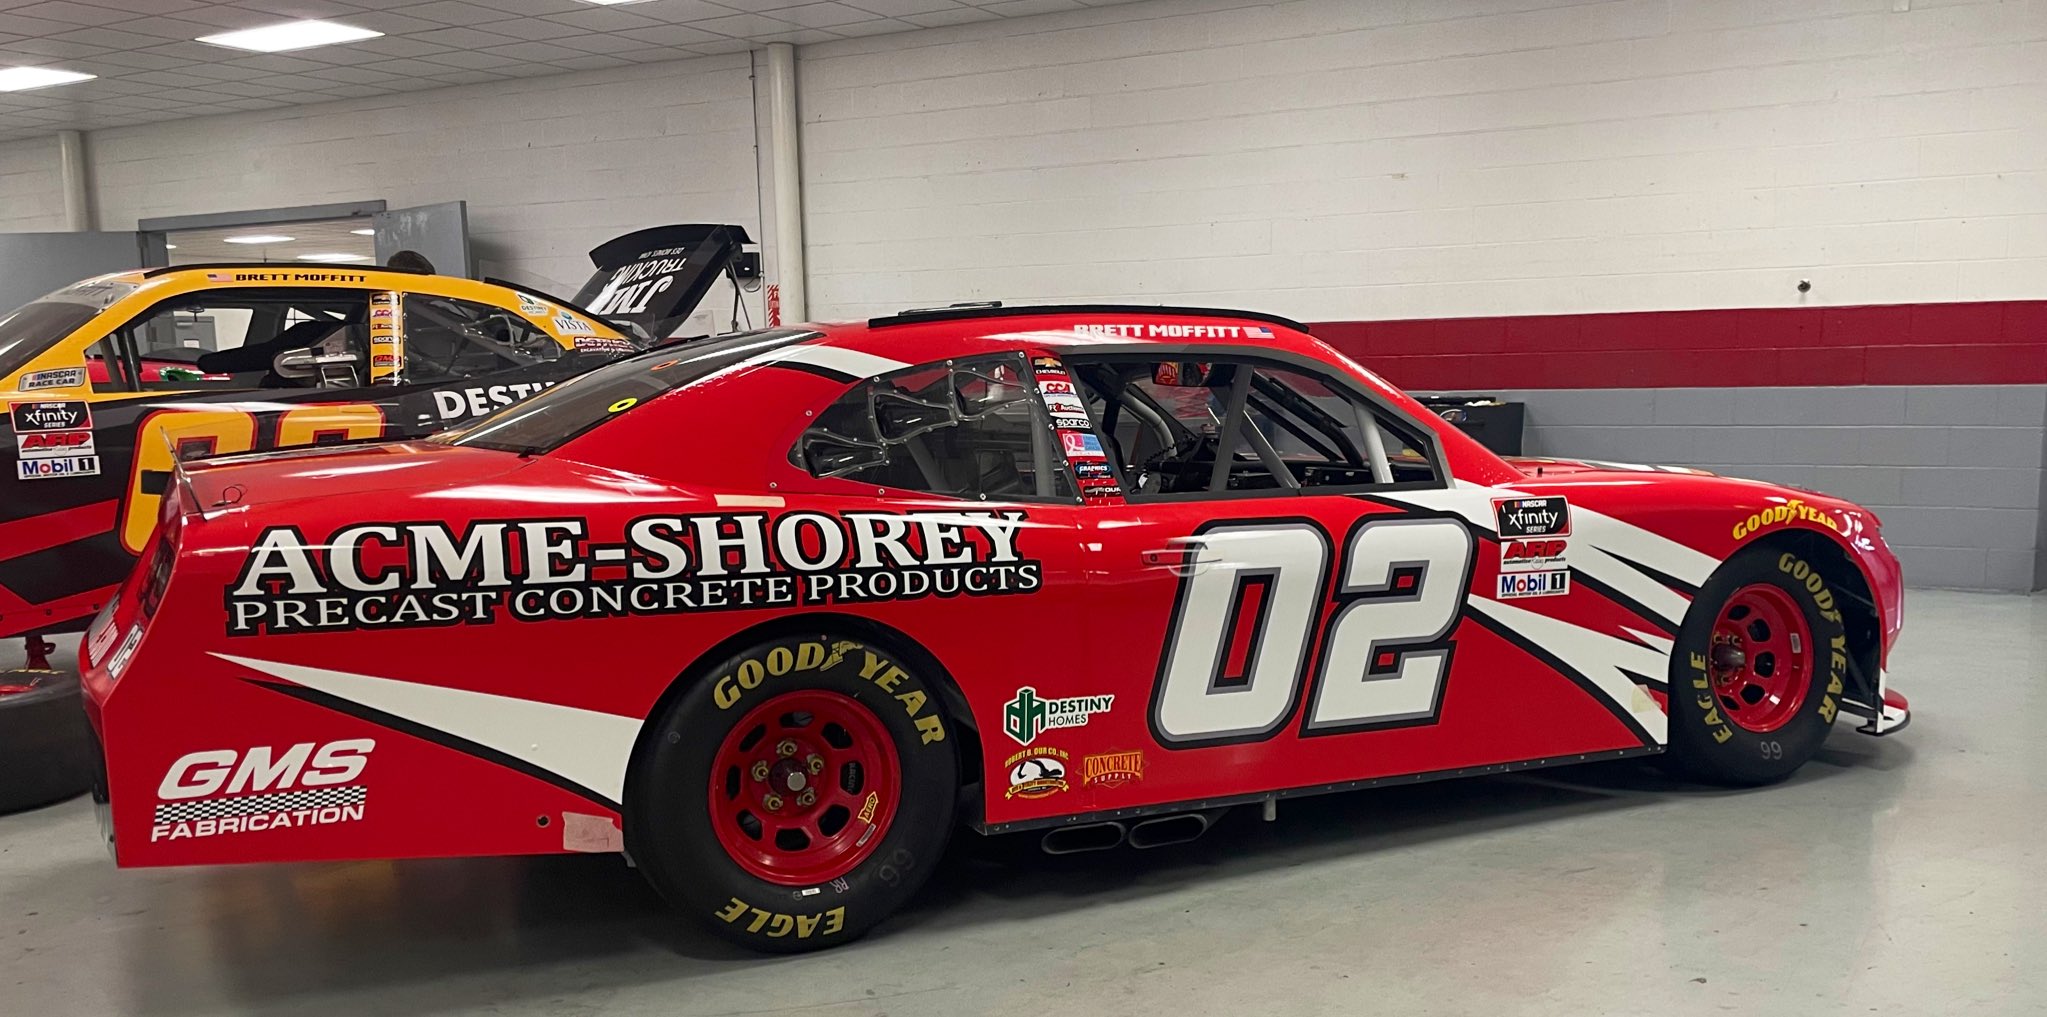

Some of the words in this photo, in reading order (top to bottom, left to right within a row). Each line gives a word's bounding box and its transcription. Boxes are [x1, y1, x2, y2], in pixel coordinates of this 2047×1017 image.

[235, 273, 290, 281] BRETT
[294, 274, 367, 283] MOFFITT
[555, 319, 591, 331] VISTA
[1073, 323, 1144, 337] BRETT
[1149, 324, 1240, 338] MOFFITT
[28, 380, 54, 388] RACE
[56, 378, 75, 386] CAR
[38, 370, 76, 380] NASCAR
[25, 410, 78, 425] xfinity
[1056, 418, 1089, 427] sparco
[21, 432, 91, 448] ARP
[22, 458, 74, 475] Mobil
[1522, 500, 1547, 508] NASCAR
[1508, 509, 1558, 530] xfinity
[1526, 525, 1547, 533] SERIES
[232, 511, 1025, 597] ACME-SHOREY
[1503, 540, 1567, 559] ARP
[1501, 573, 1547, 593] Mobil
[233, 591, 496, 630] PRECAST
[515, 575, 792, 616] CONCRETE
[809, 565, 1039, 600] PRODUCTS
[1151, 514, 1474, 746] 02
[1049, 697, 1113, 715] DESTINY
[1691, 651, 1733, 744] EAGLE
[1049, 713, 1087, 726] HOMES
[157, 738, 376, 800] GMS
[1085, 753, 1141, 778] CONCRETE
[1094, 773, 1131, 784] SUPPLY
[863, 797, 876, 819] AERO
[151, 805, 364, 842] FABRICATION
[714, 897, 845, 939] EAGLE
